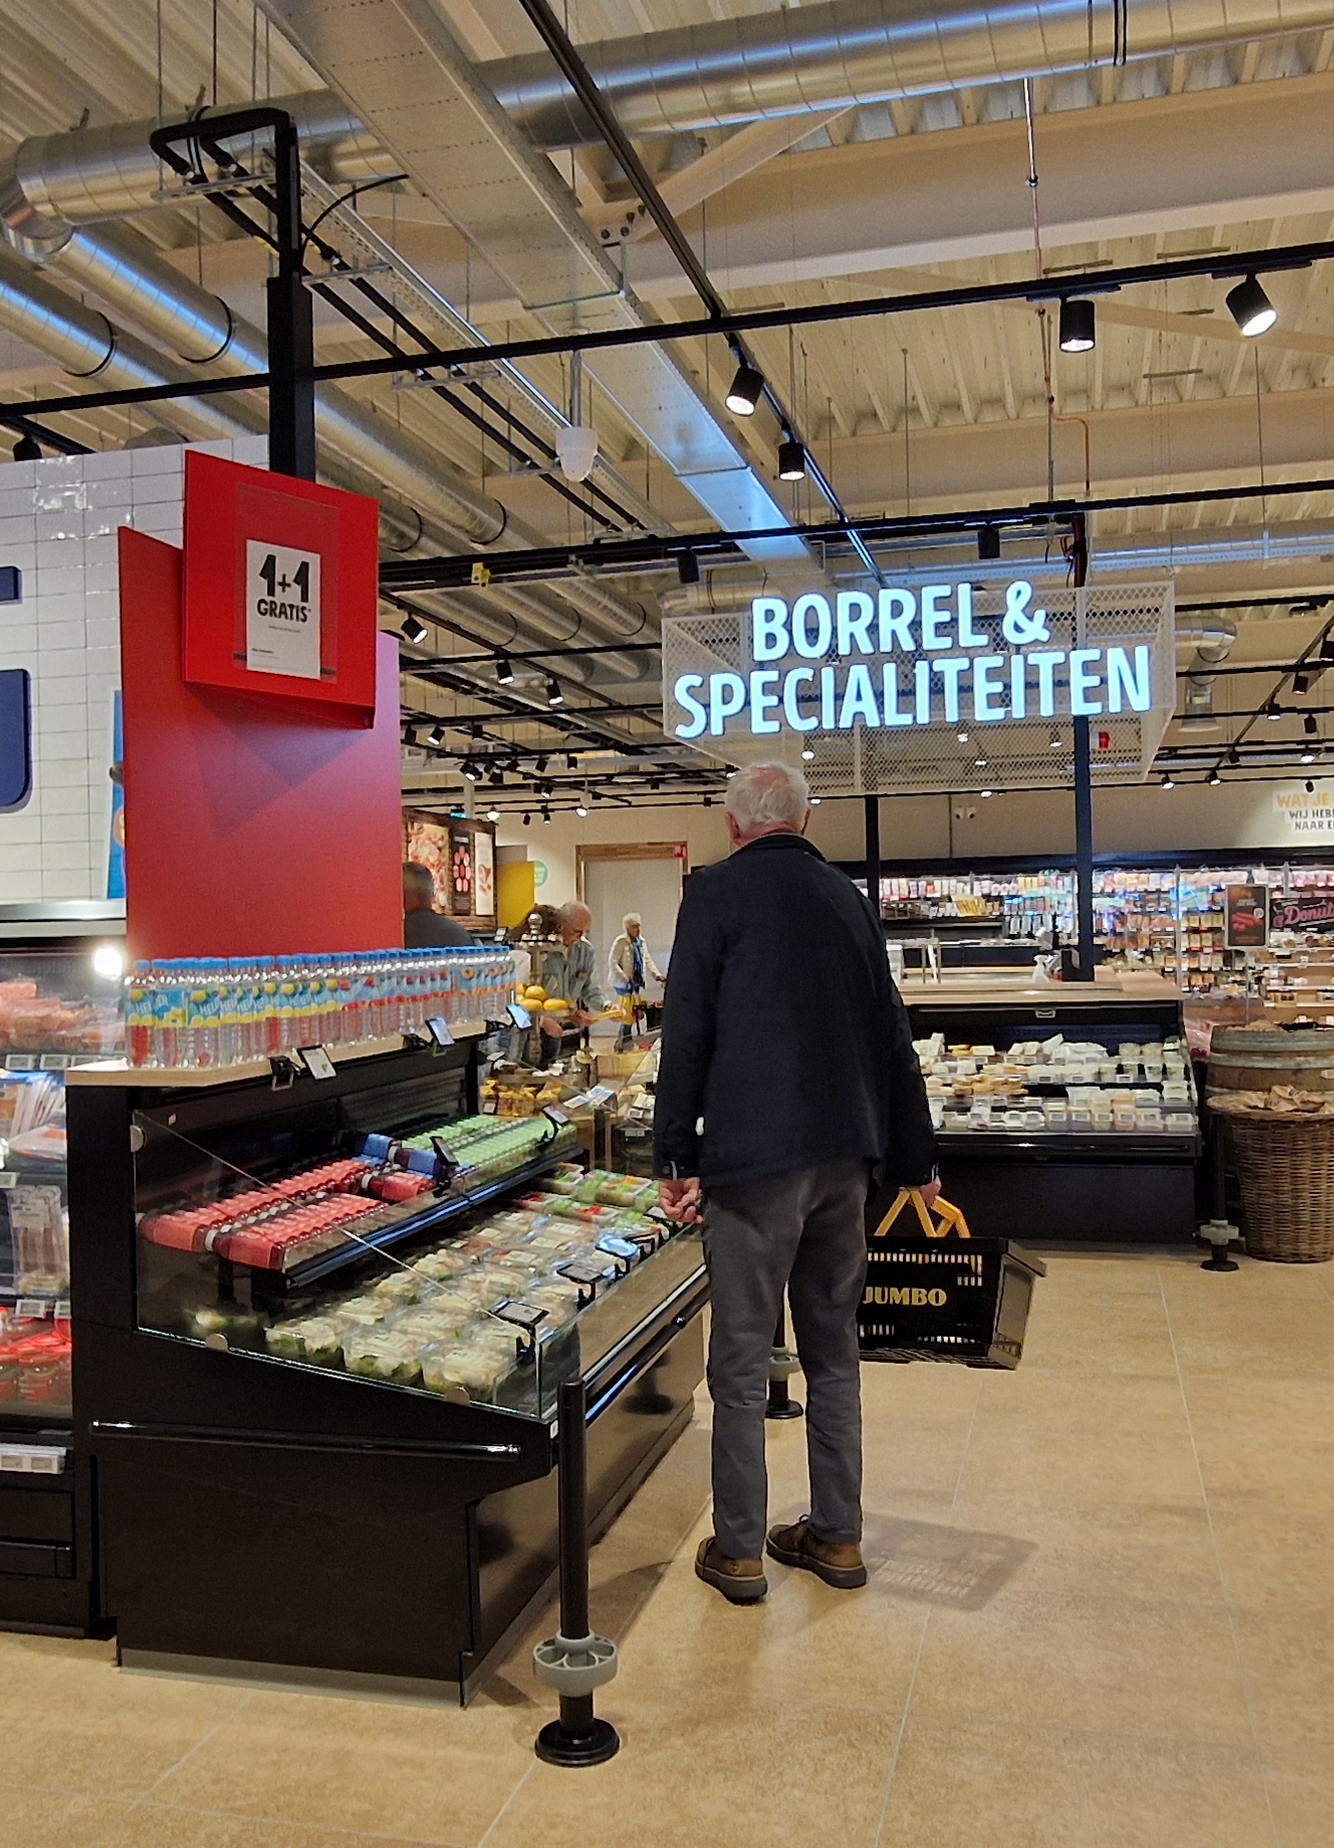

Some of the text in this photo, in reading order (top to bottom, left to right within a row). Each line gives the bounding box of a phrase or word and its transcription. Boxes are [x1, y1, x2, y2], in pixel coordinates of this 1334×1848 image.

[259, 554, 310, 603] 1+1
[752, 580, 1052, 662] BORREL &
[673, 645, 1152, 740] SPECIALITEITEN
[1277, 794, 1311, 808] WAT
[1314, 793, 1329, 807] JE
[1289, 810, 1308, 820] WIJ
[1295, 820, 1324, 831] NAAR
[862, 1286, 947, 1307] JUMBO
